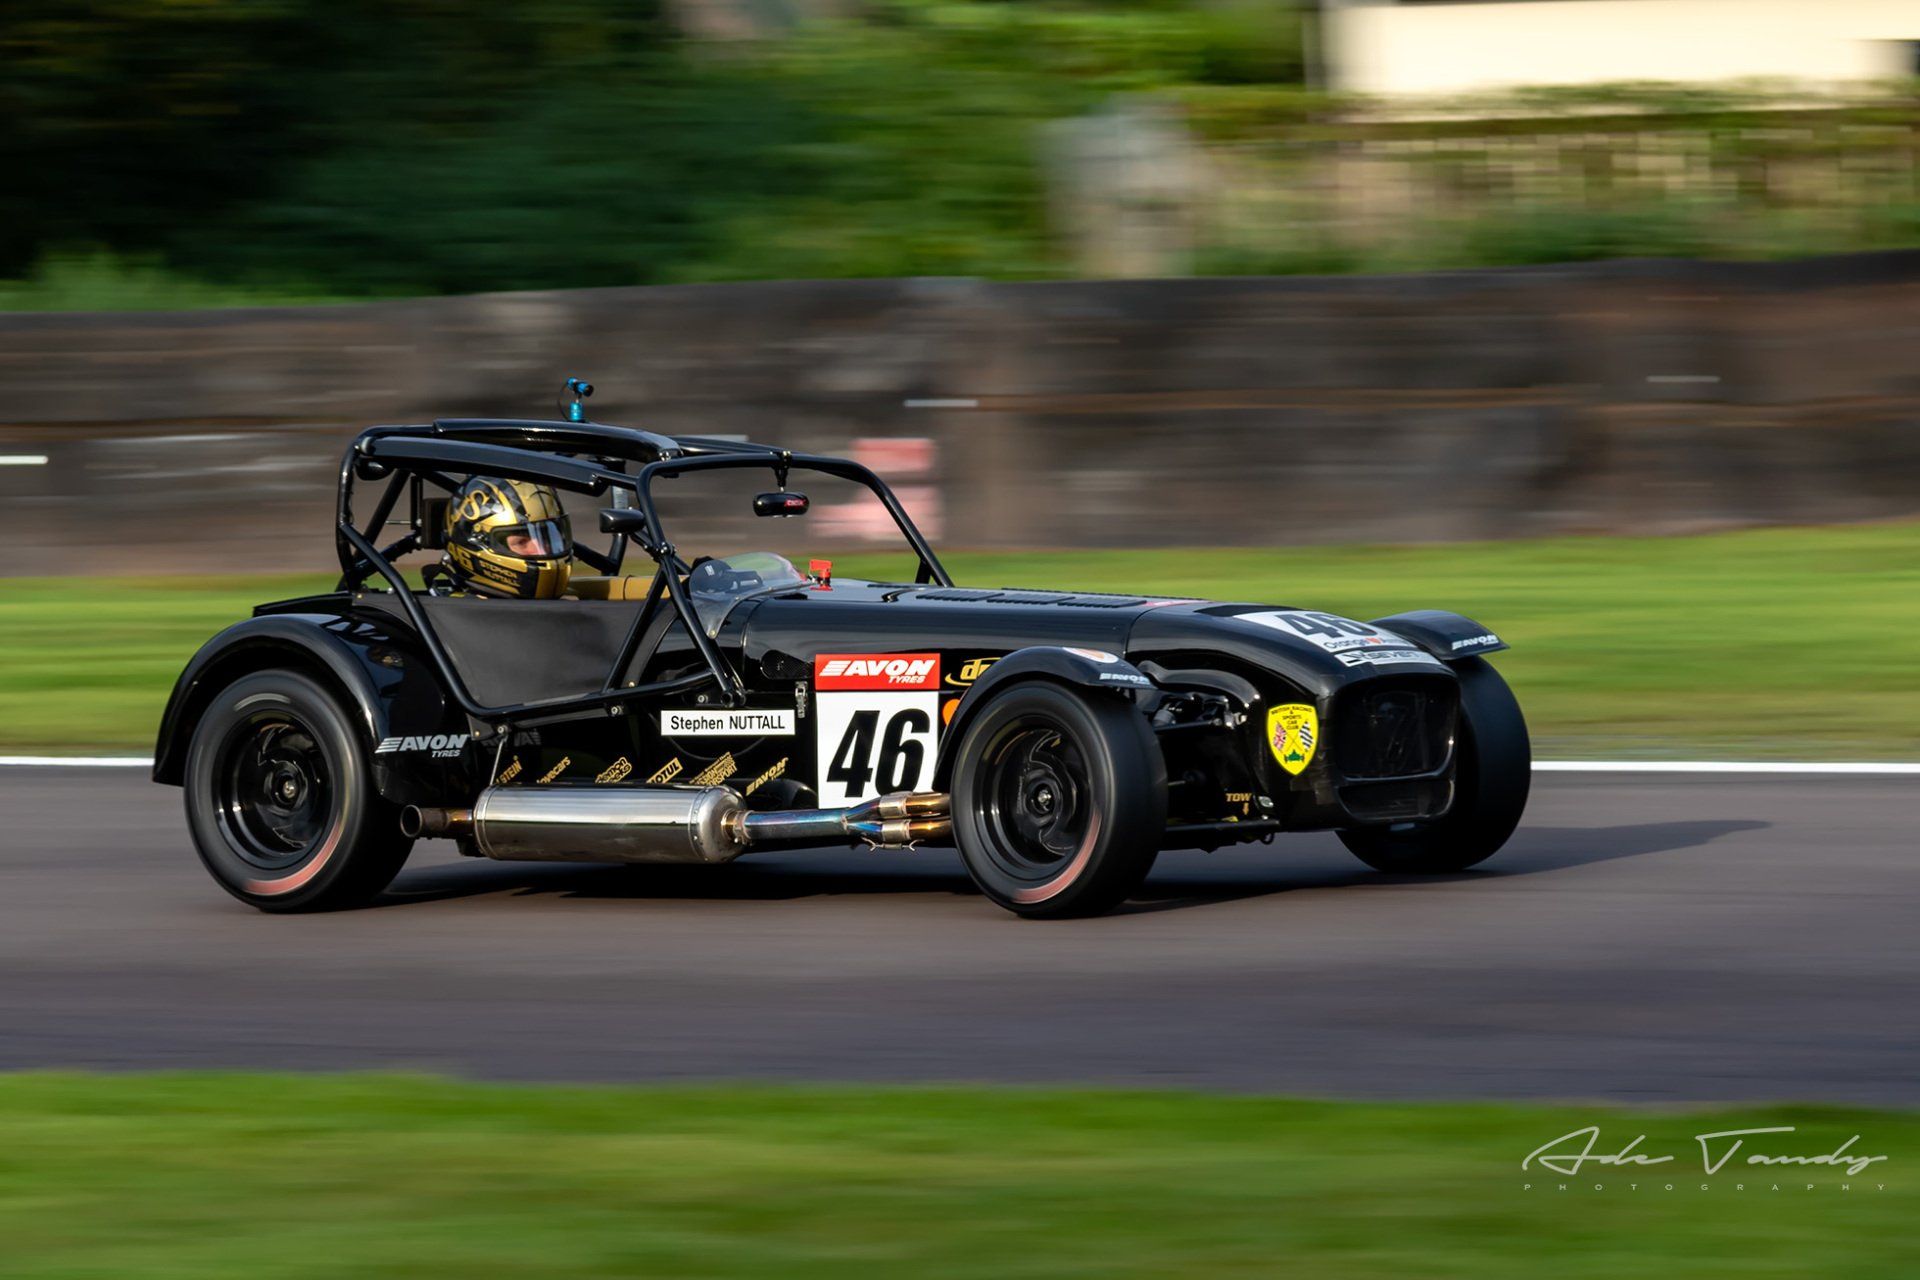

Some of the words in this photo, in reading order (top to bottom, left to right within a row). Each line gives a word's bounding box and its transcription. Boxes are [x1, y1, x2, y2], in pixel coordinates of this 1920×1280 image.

[1275, 613, 1378, 637] 46
[844, 660, 936, 677] AVON
[888, 675, 926, 684] TYRES
[670, 715, 724, 732] Stephen
[729, 715, 785, 730] NUTTALL
[399, 734, 470, 752] AVON
[431, 749, 461, 758] TYRES
[826, 708, 930, 798] 46
[1225, 792, 1252, 802] TOW
